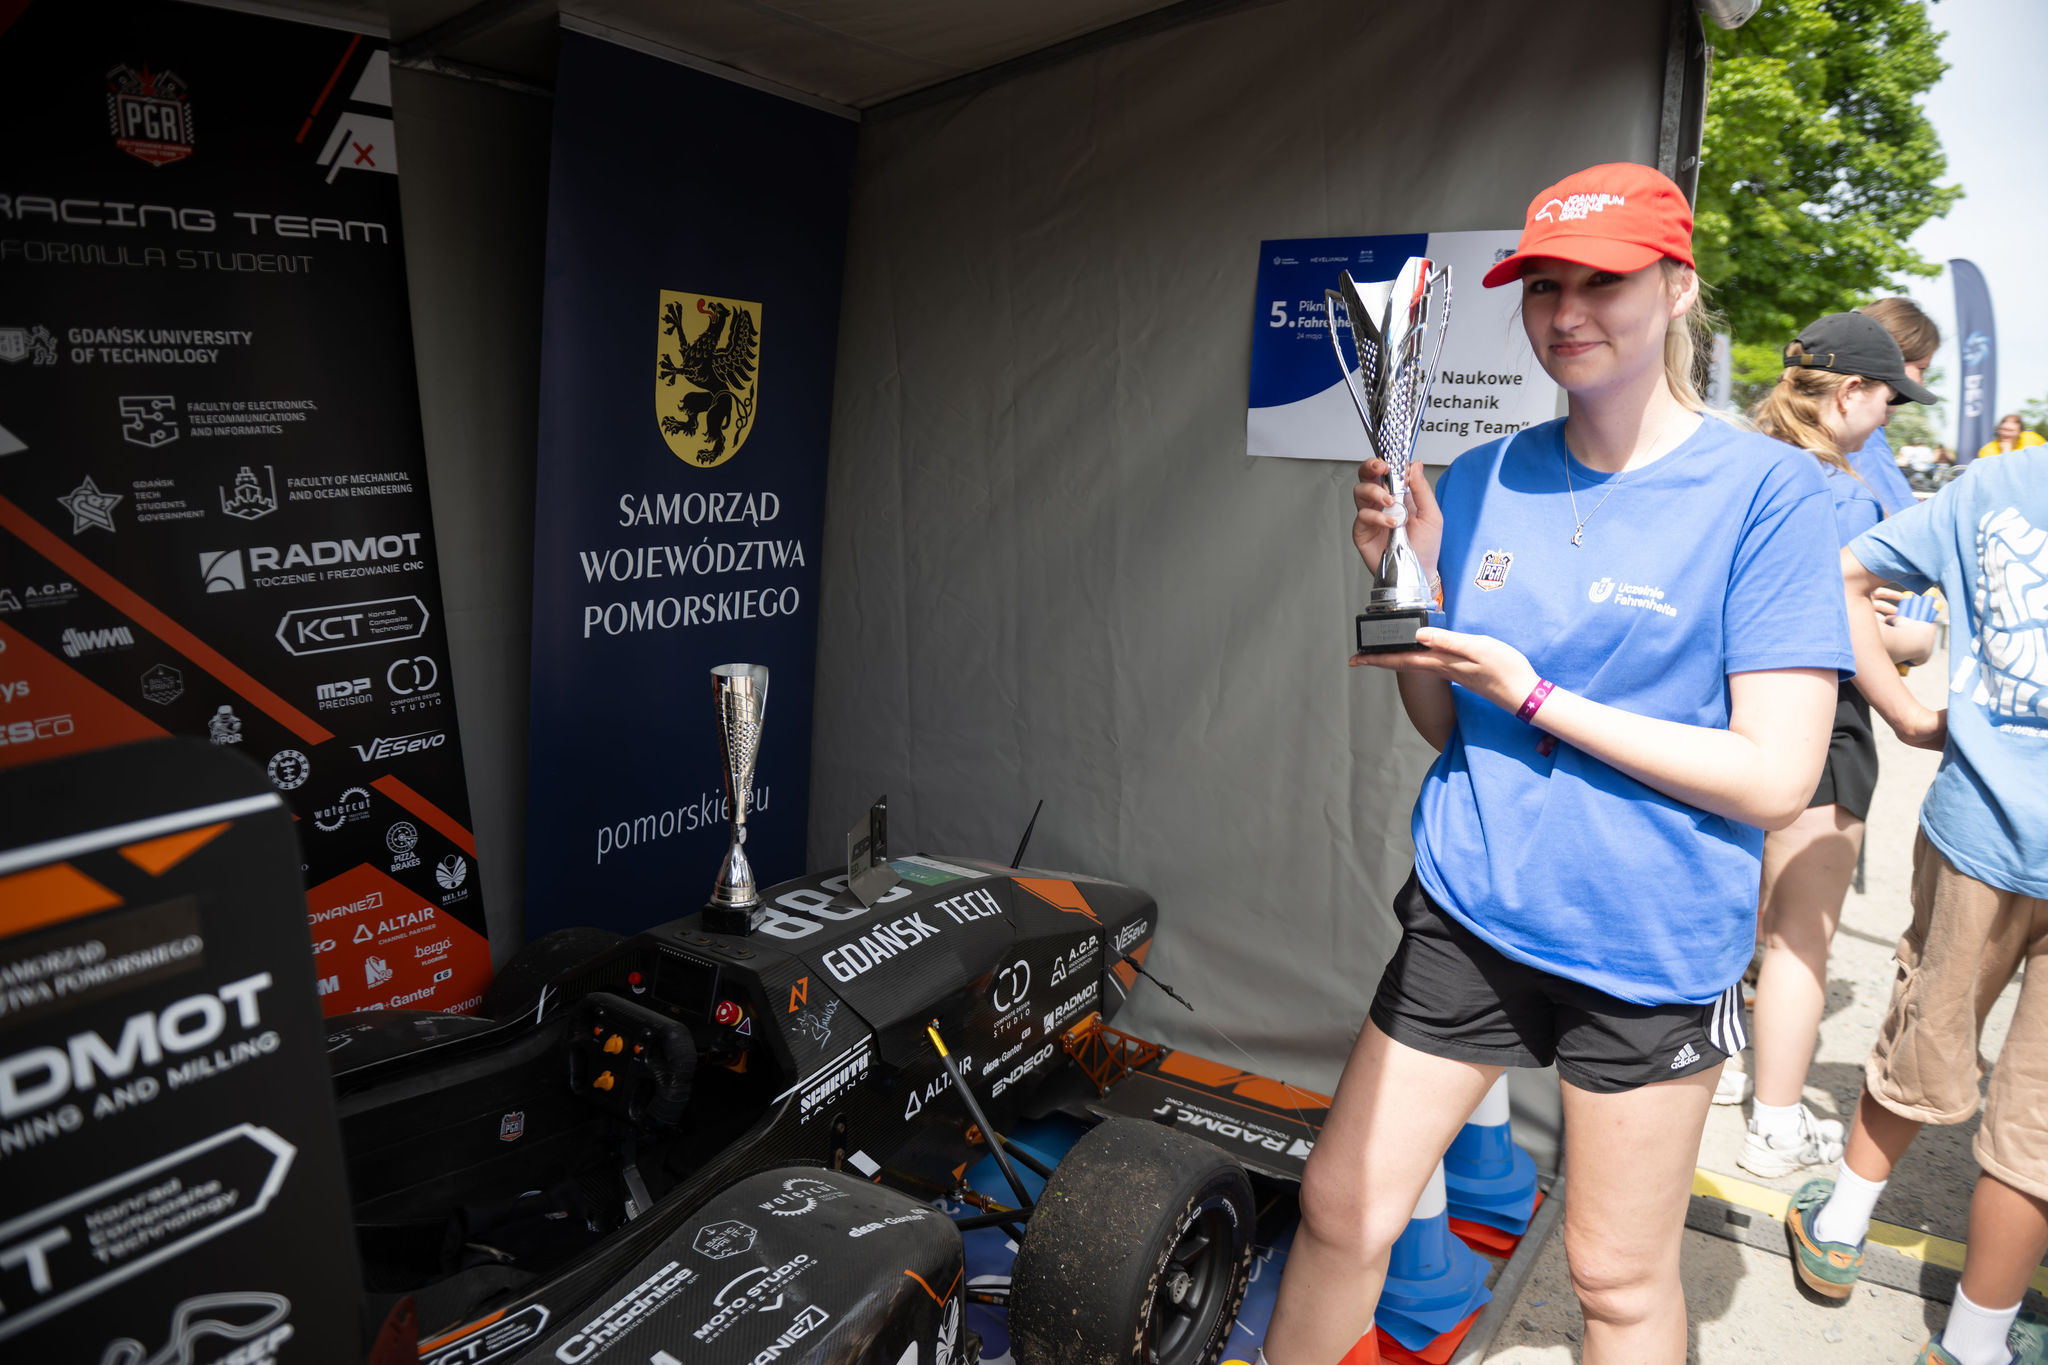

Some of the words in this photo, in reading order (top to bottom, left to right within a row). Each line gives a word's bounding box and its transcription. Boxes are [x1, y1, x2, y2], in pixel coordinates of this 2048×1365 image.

[125, 101, 178, 142] PGR
[233, 211, 389, 244] TEAM
[1, 240, 167, 267] FORMULA
[176, 249, 314, 274] STUDENT
[1270, 301, 1296, 328] 5.
[1299, 300, 1326, 312] Pikni
[68, 326, 146, 344] GDAŃSK
[149, 329, 253, 346] UNIVERSITY
[70, 348, 94, 364] OF
[99, 348, 219, 364] TECHNOLOGY
[1442, 371, 1523, 386] Naukowe
[187, 402, 231, 412] FACULTY
[232, 401, 246, 411] OF
[189, 412, 307, 424] TELECOMMUNICATIONS
[190, 427, 213, 437] AND
[214, 425, 283, 437] INFORMATICS
[287, 476, 334, 488] FACULTY
[334, 475, 349, 486] OF
[350, 472, 410, 484] MECHANICAL
[288, 490, 313, 501] AND
[313, 488, 349, 499] OCEAN
[350, 484, 413, 496] ENGINEERING
[618, 491, 780, 528] SAMORZĄD
[248, 532, 421, 573] RADMOT
[579, 536, 806, 584] WOJEWÓDZTWA
[254, 572, 316, 588] TOCZENIE
[327, 564, 400, 580] FREZOWANIE
[402, 561, 424, 572] CNC
[1618, 583, 1664, 600] Uczelnie
[583, 586, 801, 638] POMORSKIEGO
[1614, 594, 1677, 618] Fahrenheita
[297, 613, 364, 644] KCT
[368, 615, 408, 626] Composite
[370, 622, 413, 635] Technology
[318, 693, 373, 711] PRECISION
[314, 799, 371, 819] watercut
[391, 859, 421, 873] BRAKES
[393, 852, 416, 863] PIZZA
[377, 907, 435, 935] ALTAIR
[821, 911, 941, 983] GDAŃSK
[933, 888, 1003, 925] TECH
[1055, 980, 1098, 1020] RADMOT
[991, 1043, 1055, 1099] ENDEGO
[1670, 1053, 1700, 1070] adidas
[93, 1075, 160, 1122] AND
[166, 1030, 281, 1090] MILLING
[800, 1071, 869, 1126] RACING
[693, 1297, 747, 1340] MOTO
[746, 1254, 809, 1298] STUDIO
